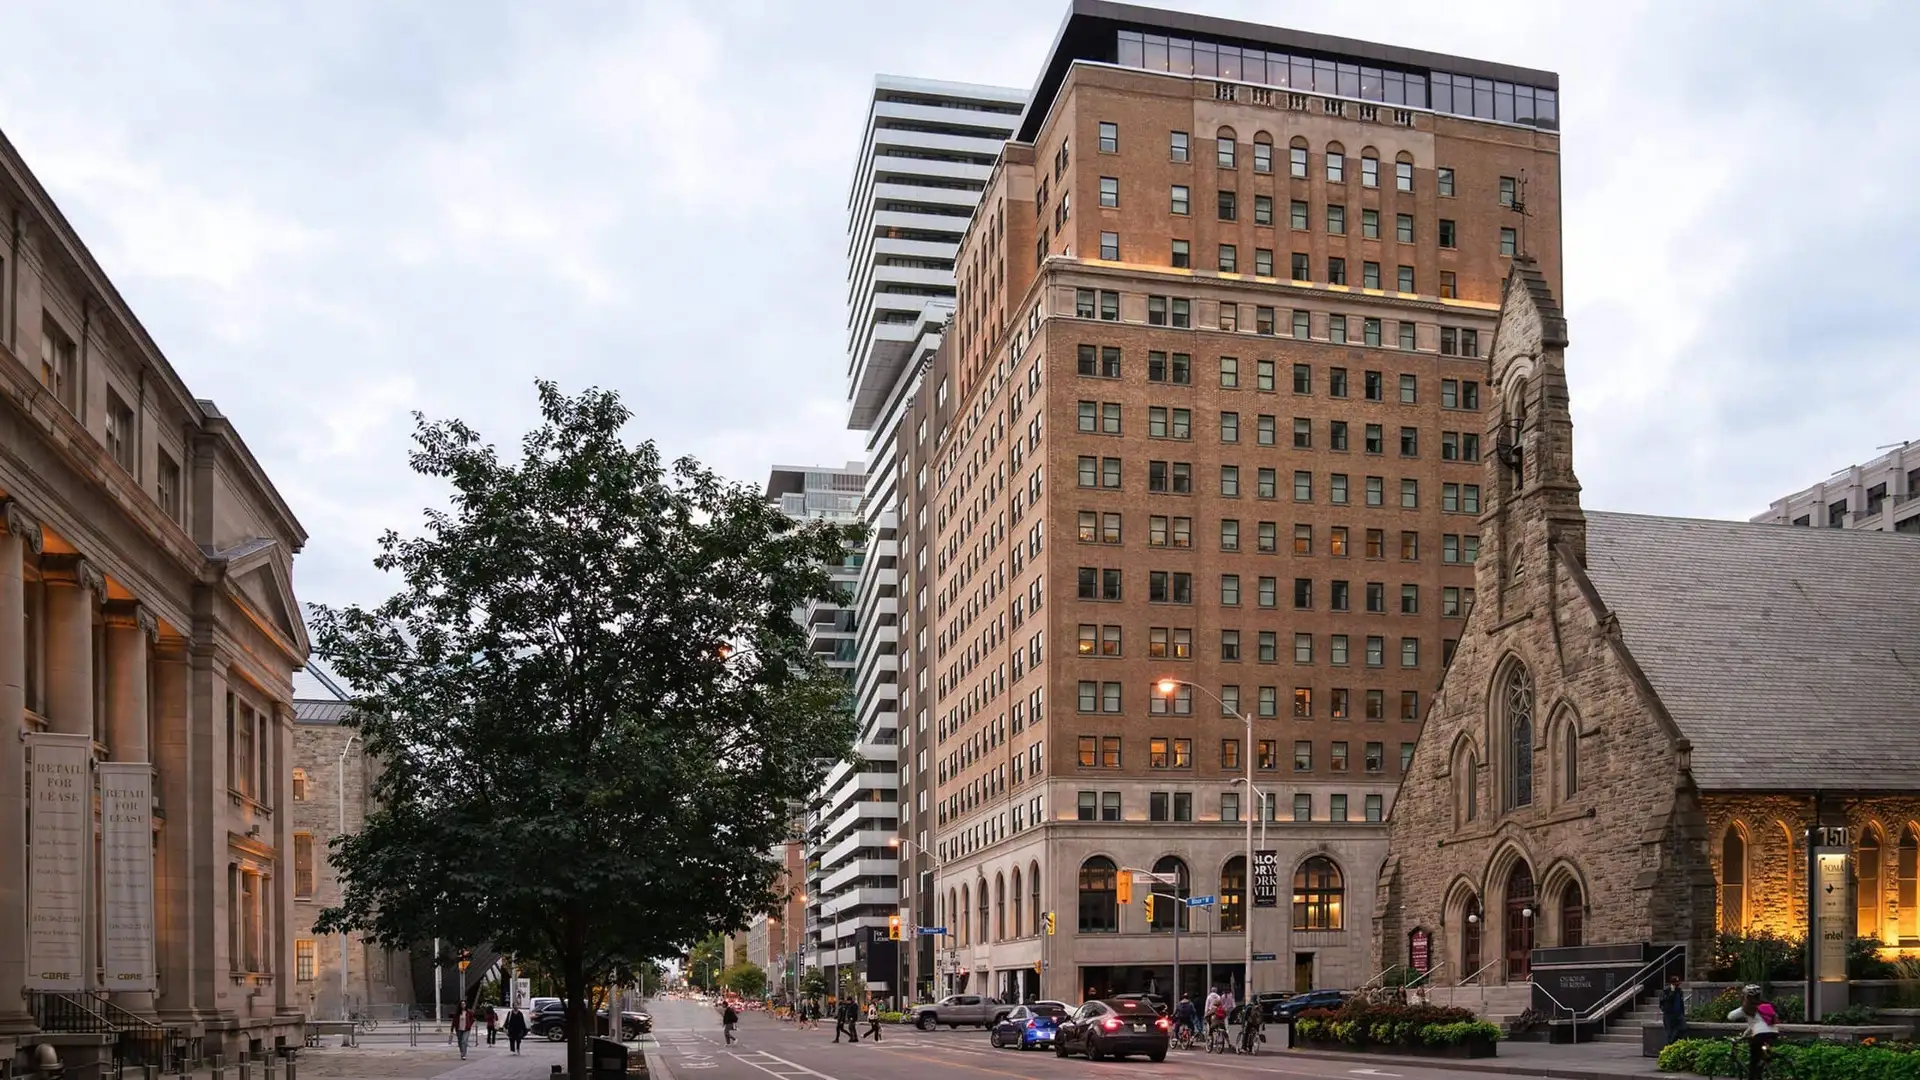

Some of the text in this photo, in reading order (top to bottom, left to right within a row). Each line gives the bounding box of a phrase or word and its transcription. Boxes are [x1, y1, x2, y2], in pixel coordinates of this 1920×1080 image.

[37, 763, 83, 774] RETAIL
[47, 778, 72, 788] FOR
[40, 792, 80, 802] LEASE
[106, 789, 146, 798] RETAIL
[115, 802, 138, 810] FOR
[109, 814, 144, 823] LEASE
[1818, 826, 1849, 847] 150
[1824, 930, 1844, 940] intel
[41, 972, 71, 980] CBRE
[117, 973, 142, 981] CBRE
